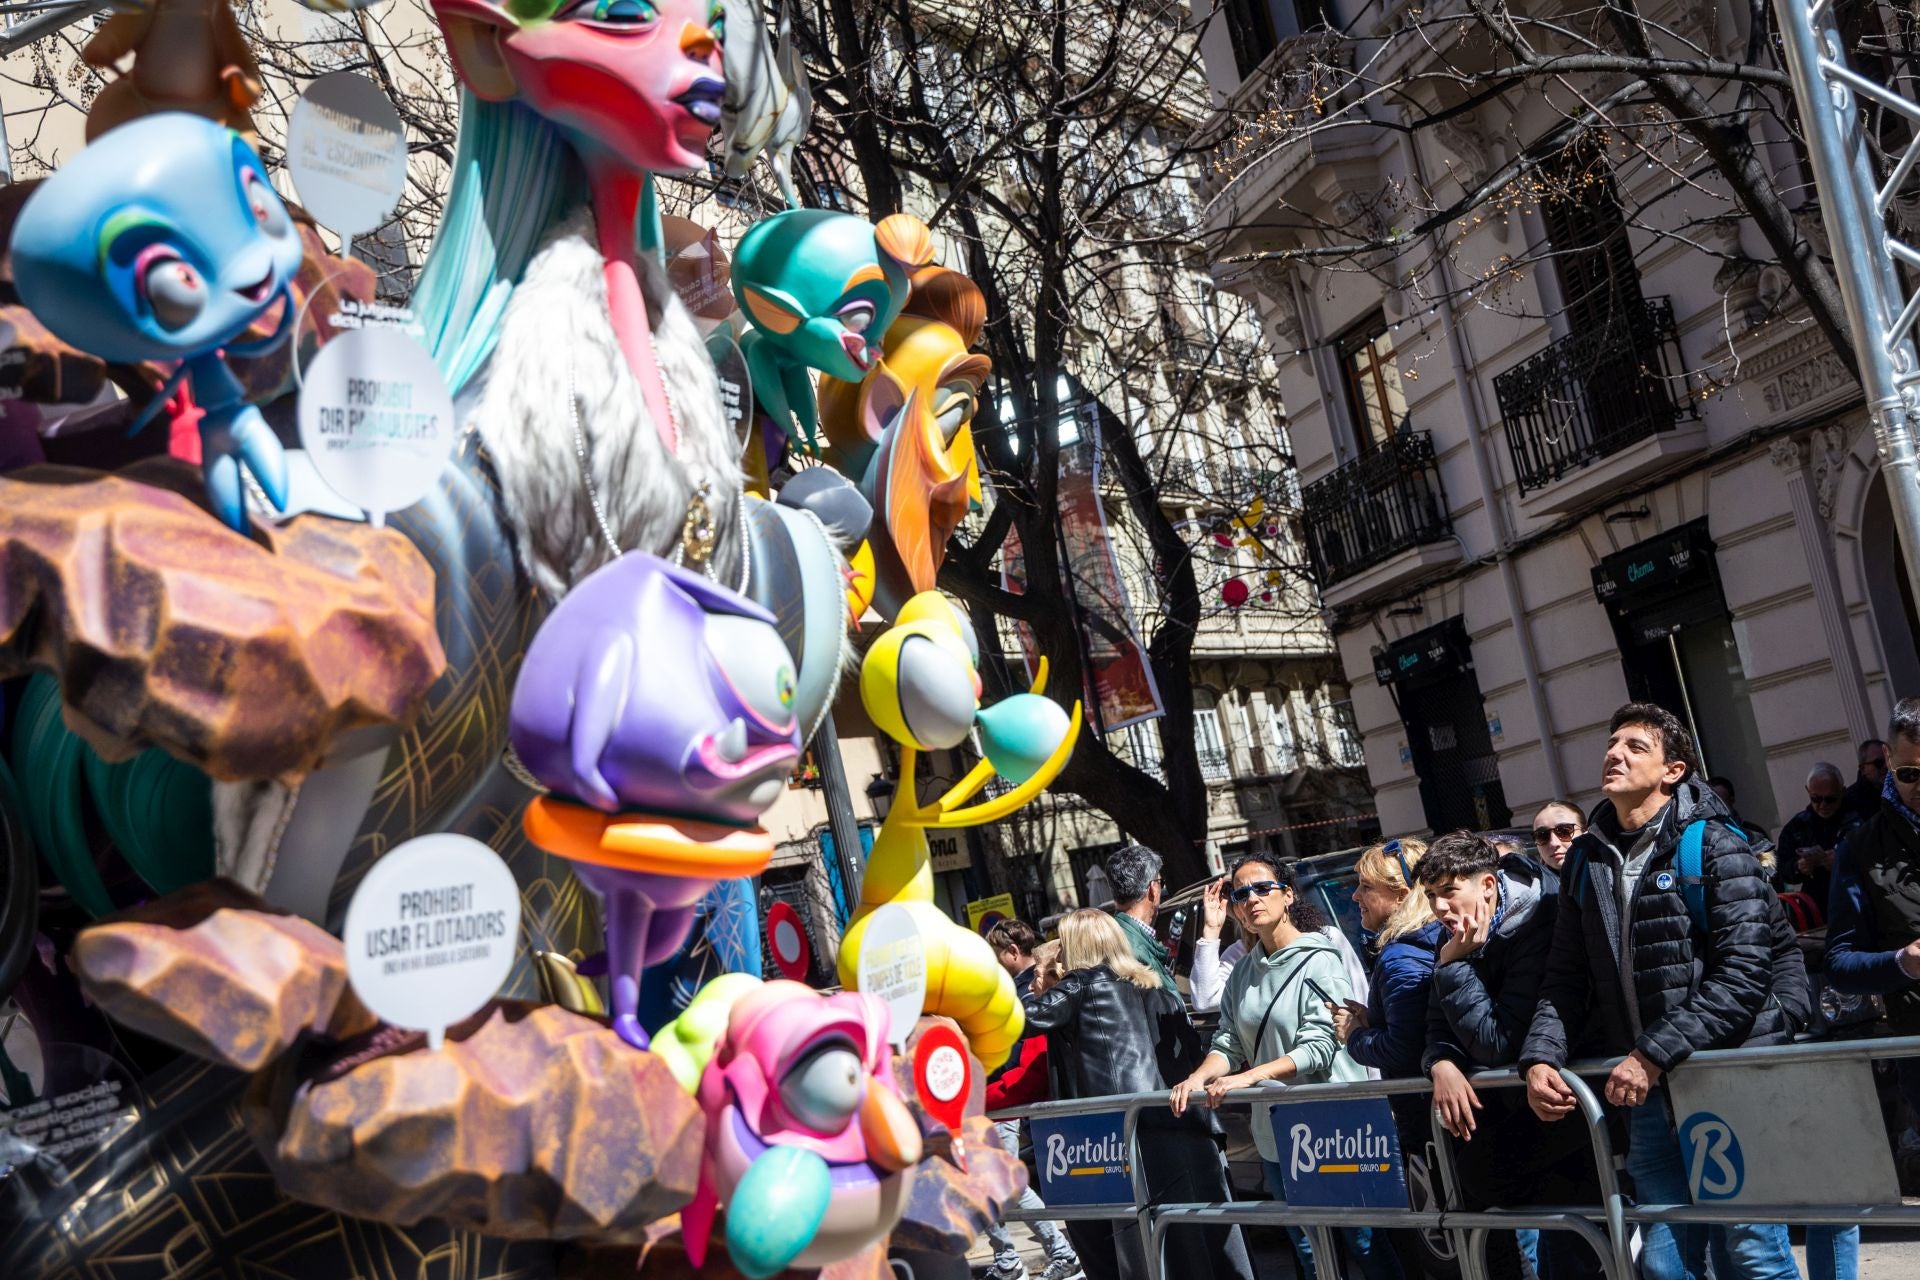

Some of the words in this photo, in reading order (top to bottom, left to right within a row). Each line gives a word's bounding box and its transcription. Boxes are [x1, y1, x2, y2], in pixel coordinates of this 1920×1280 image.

[347, 378, 413, 409] PROHIBIT
[320, 406, 345, 434] DIR
[400, 883, 474, 921] PROHIBIT
[366, 925, 411, 958] USAR
[416, 910, 506, 950] FLOTADORS
[1290, 1123, 1391, 1182] Bertolín
[1360, 1163, 1380, 1173] GRUPO
[1105, 1165, 1123, 1175] GRUPO
